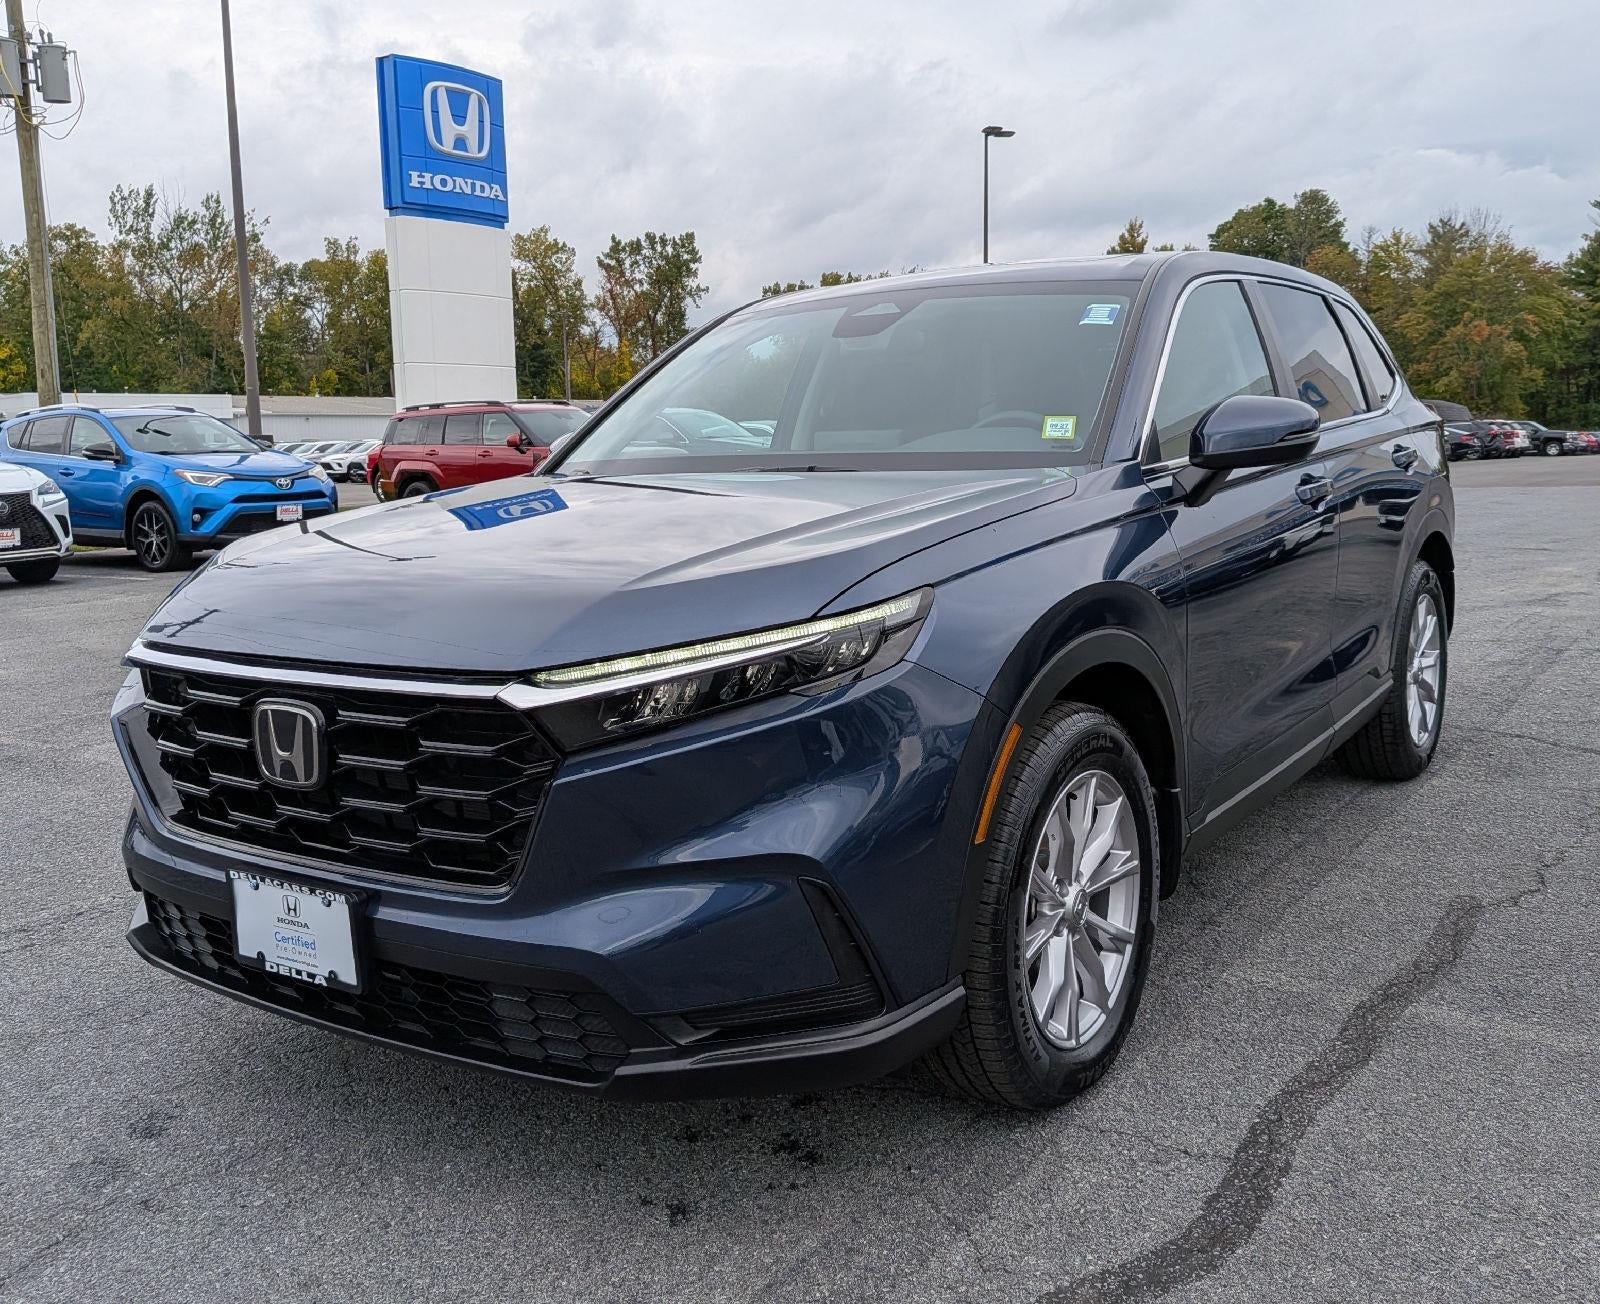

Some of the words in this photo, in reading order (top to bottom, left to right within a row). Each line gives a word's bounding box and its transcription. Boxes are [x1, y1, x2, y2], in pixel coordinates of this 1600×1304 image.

[408, 171, 506, 201] HONDA
[229, 870, 346, 904] DELLACARS.COM
[276, 917, 311, 930] HONDA
[274, 931, 316, 951] Certified
[275, 943, 318, 960] Pre-Owned
[265, 961, 328, 987] DELLA
